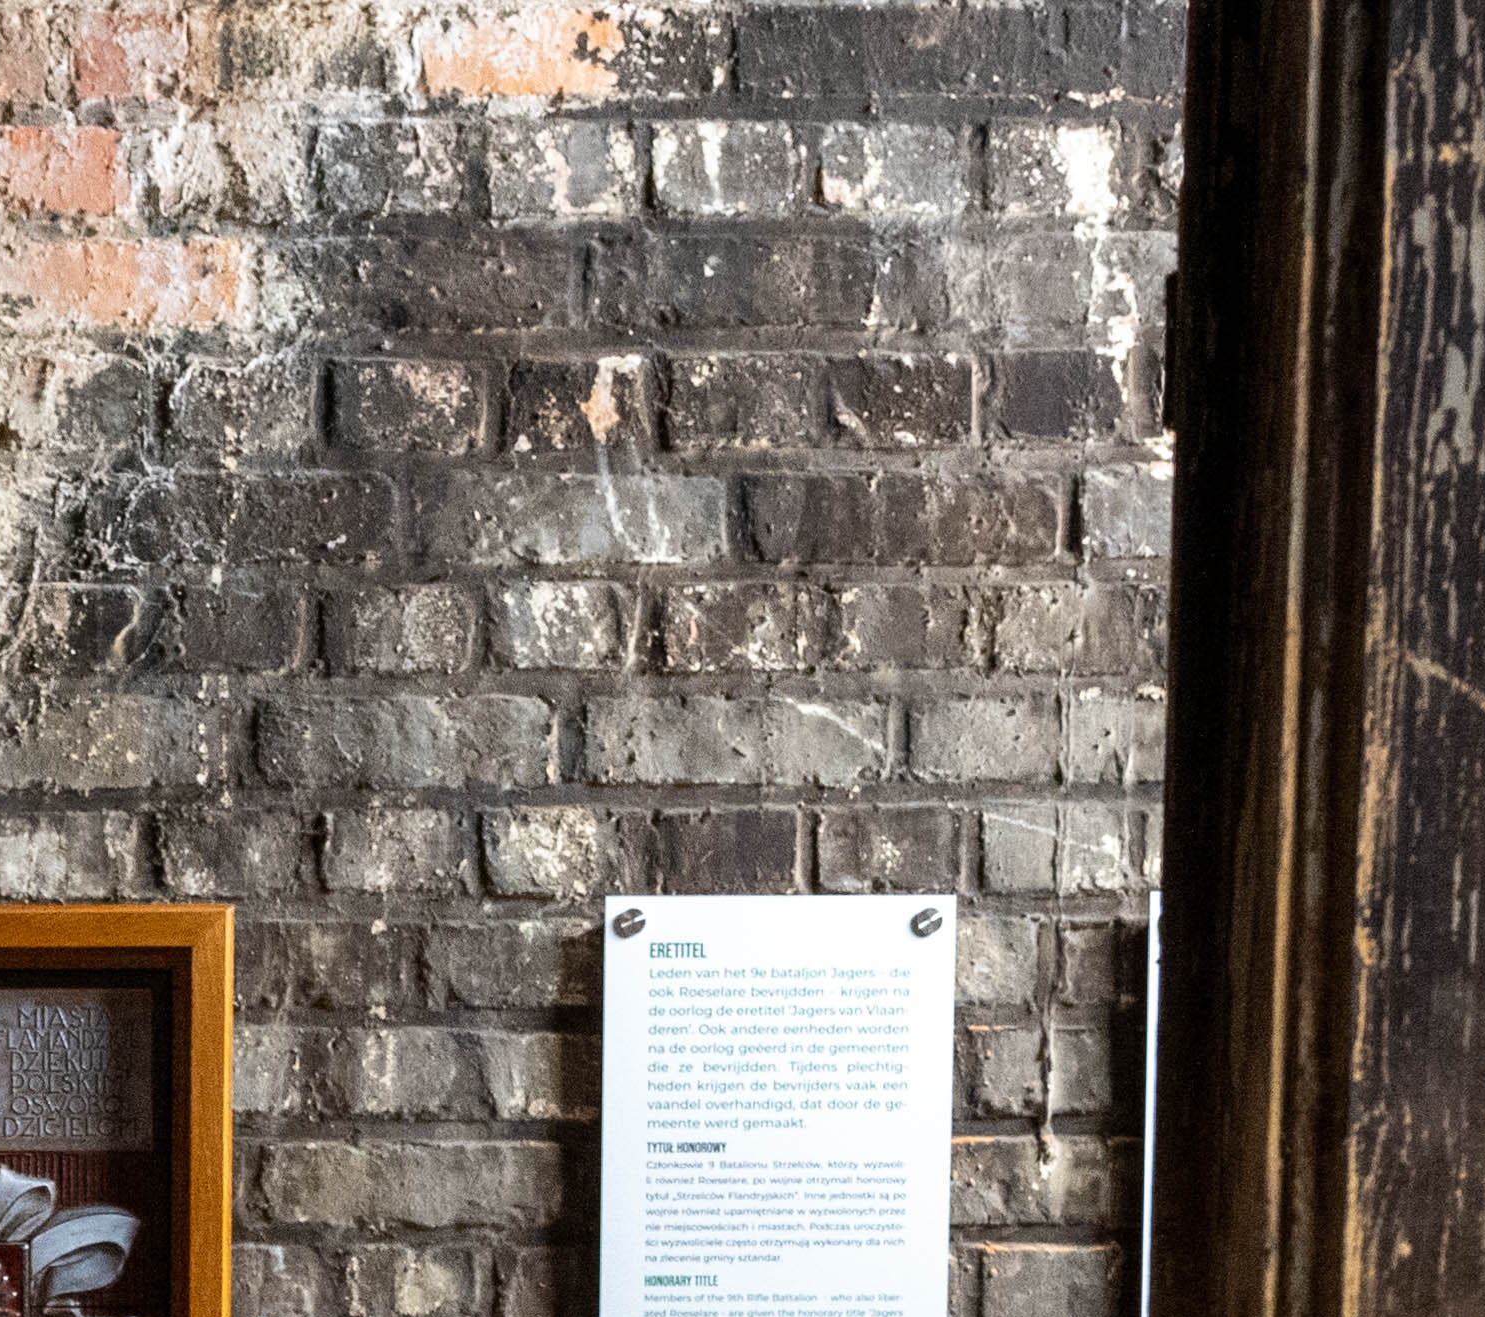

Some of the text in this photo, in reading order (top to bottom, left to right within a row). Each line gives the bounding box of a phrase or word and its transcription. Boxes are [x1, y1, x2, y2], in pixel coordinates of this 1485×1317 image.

[649, 941, 707, 960] ERETITEL
[649, 968, 911, 980] Leden van het 9e bataljon Jagers die
[648, 986, 910, 1000] ook Roeselare bevrijdden krijgen na
[17, 1006, 115, 1028] MIASTA
[648, 1005, 666, 1016] de
[669, 1005, 713, 1019] oorlog
[716, 1006, 733, 1016] de
[736, 1006, 785, 1016] eretitel
[839, 1008, 862, 1016] van
[698, 1024, 726, 1035] Ook
[730, 1024, 779, 1035] andere
[783, 1024, 852, 1034] eenheden
[857, 1024, 909, 1034] worden
[648, 1043, 909, 1056] na de oorlog geëerd in de gemeenten
[647, 1061, 669, 1072] die
[679, 1064, 693, 1073] ze
[788, 1061, 837, 1075] Tijdens
[647, 1080, 908, 1094] heden krijgen de bevrijders vaak een
[647, 1099, 701, 1110] vaandel
[705, 1099, 795, 1112] overhandigd,
[800, 1099, 822, 1110] dat
[827, 1099, 859, 1110] door
[863, 1098, 881, 1109] de
[647, 1119, 701, 1129] meente
[704, 1117, 739, 1128] werd
[647, 1141, 727, 1154] TYTUŁ HONOROWY
[644, 1274, 718, 1288] HONORARY TITLE
[644, 1294, 692, 1302] Members
[695, 1294, 705, 1302] of
[707, 1294, 724, 1302] the
[727, 1294, 744, 1302] 9th
[747, 1293, 769, 1302] Rifle
[772, 1294, 818, 1302] Battalion
[830, 1294, 852, 1302] who
[855, 1294, 875, 1302] also
[644, 1310, 666, 1317] ated
[669, 1309, 719, 1317] Roeselare
[798, 1310, 843, 1317] honorary
[846, 1309, 866, 1317] title
